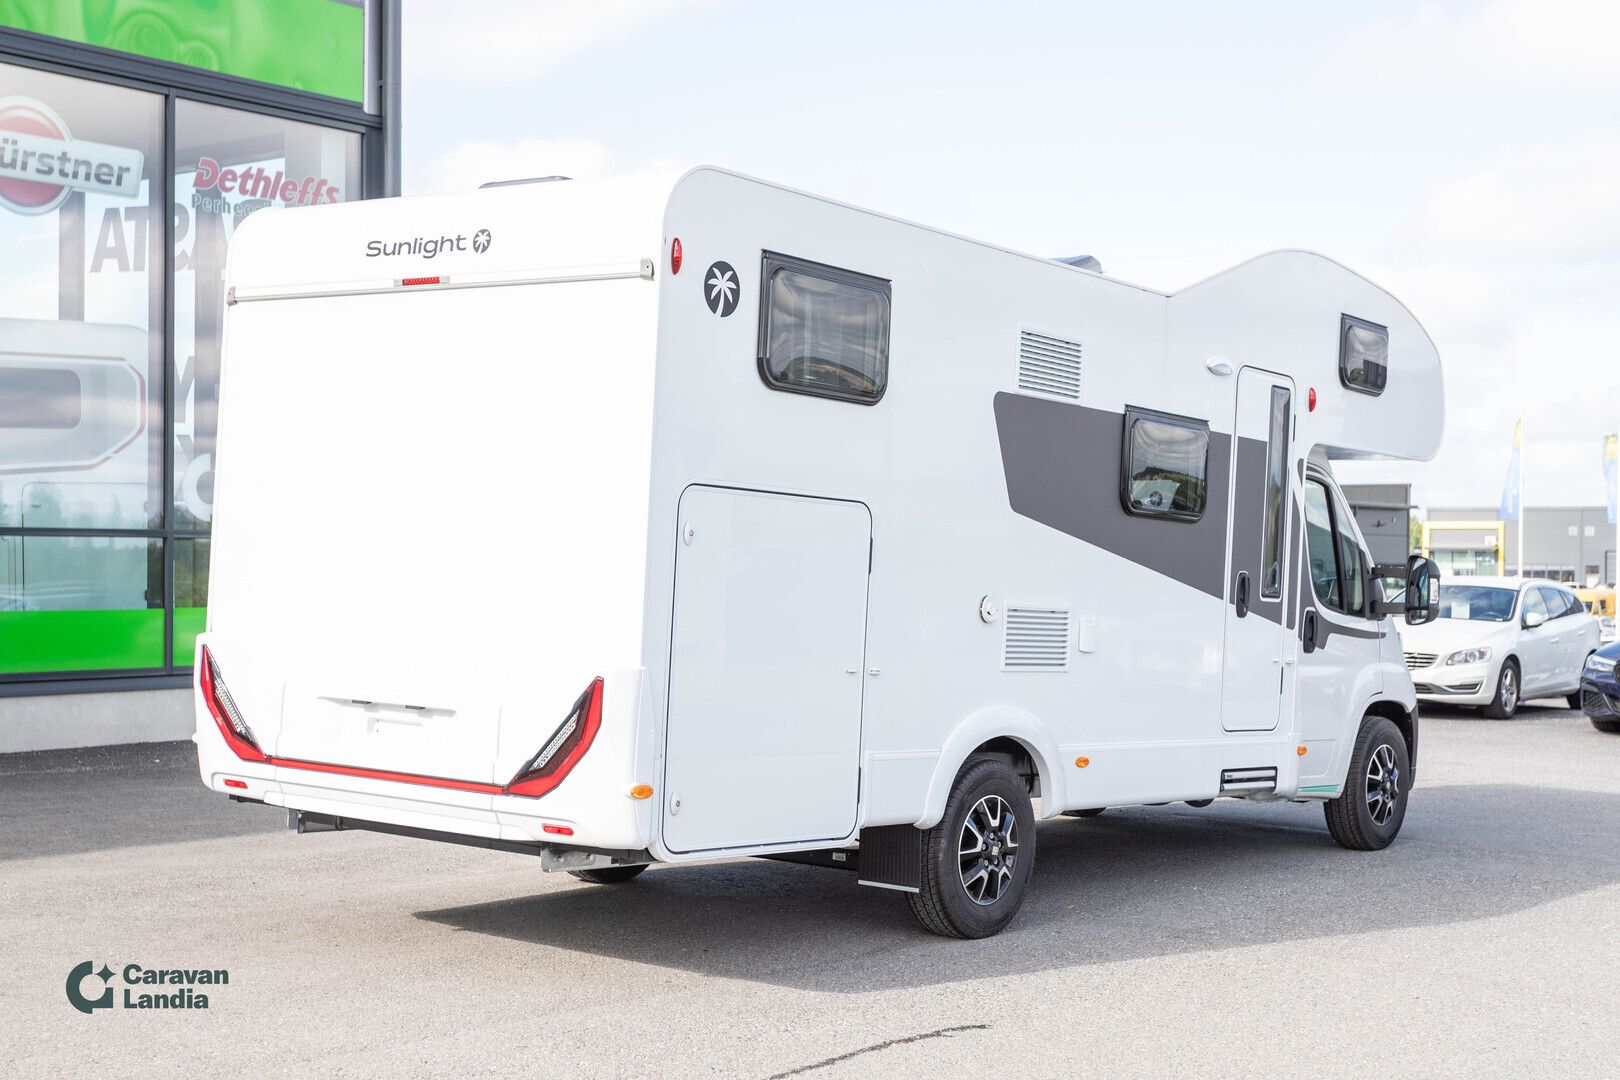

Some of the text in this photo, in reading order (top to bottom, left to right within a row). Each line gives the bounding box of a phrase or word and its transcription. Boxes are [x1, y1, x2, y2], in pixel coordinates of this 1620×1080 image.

[0, 137, 131, 187] ürstner
[192, 156, 340, 205] Dethleffs
[365, 234, 467, 259] Sunlight
